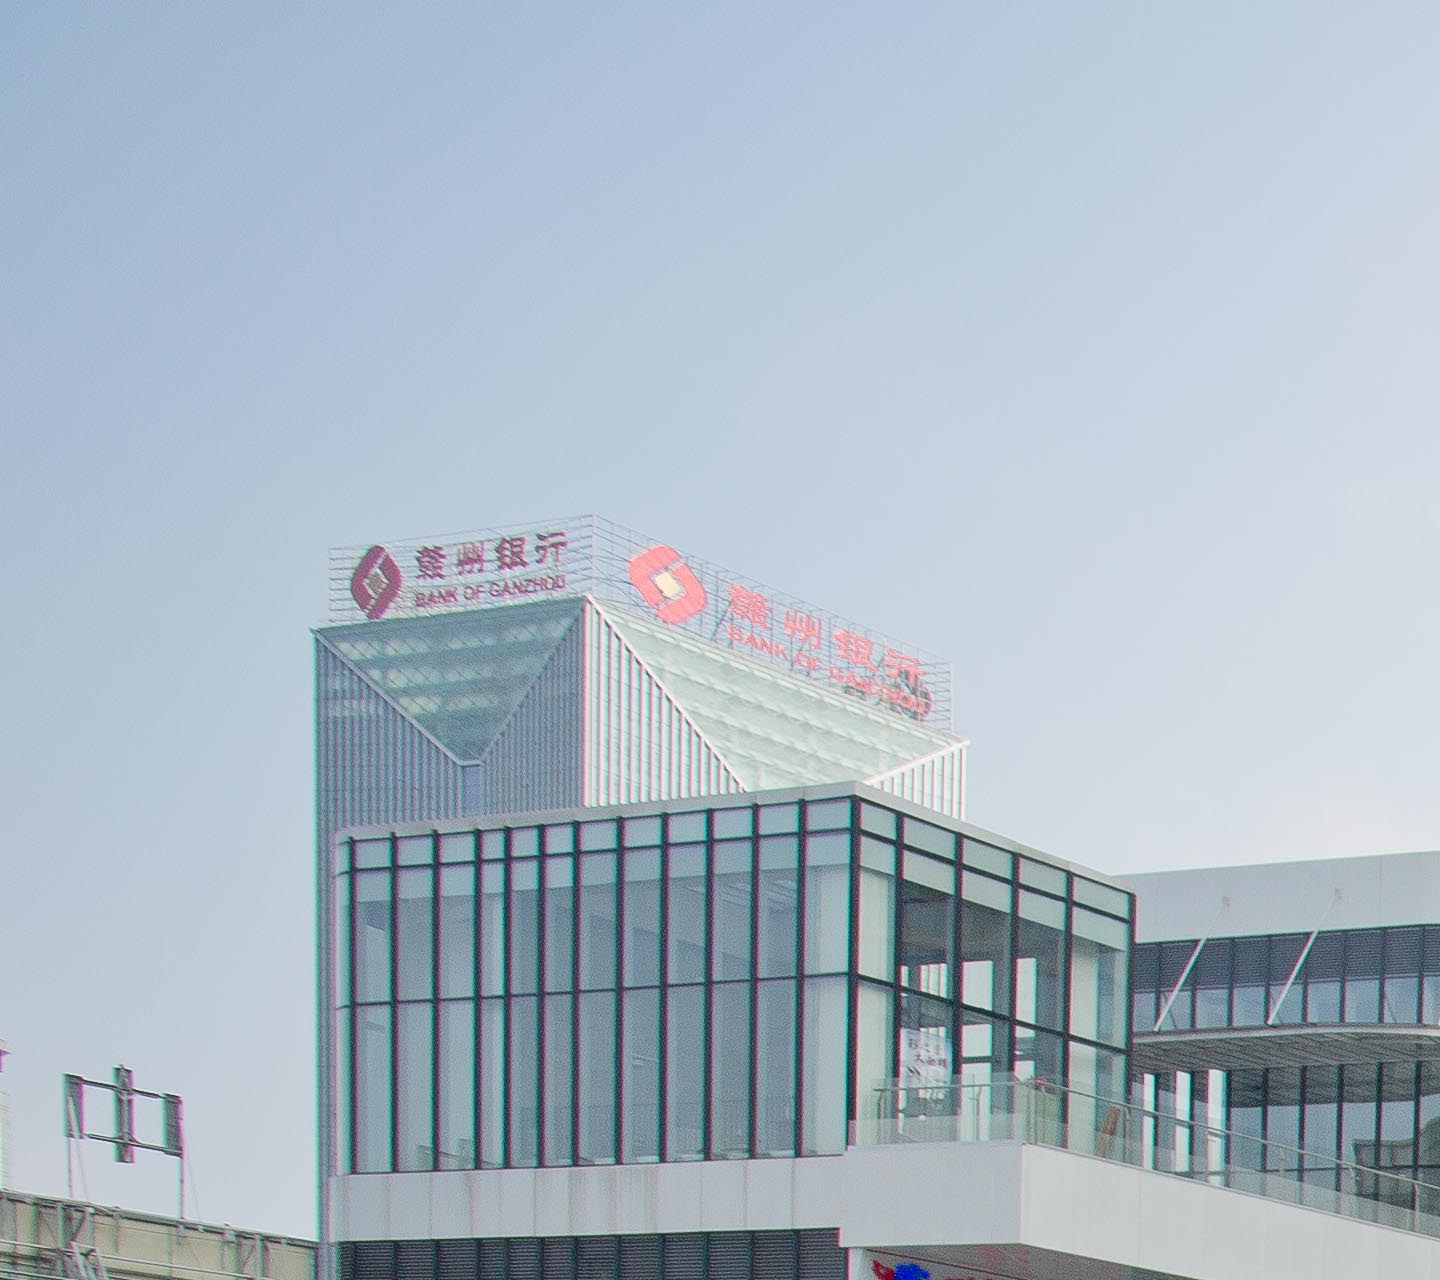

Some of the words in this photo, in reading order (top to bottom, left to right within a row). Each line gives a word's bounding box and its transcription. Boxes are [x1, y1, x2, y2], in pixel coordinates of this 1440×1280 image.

[415, 586, 459, 609] BANK
[464, 583, 485, 602] OF
[488, 574, 567, 597] GANZHOU
